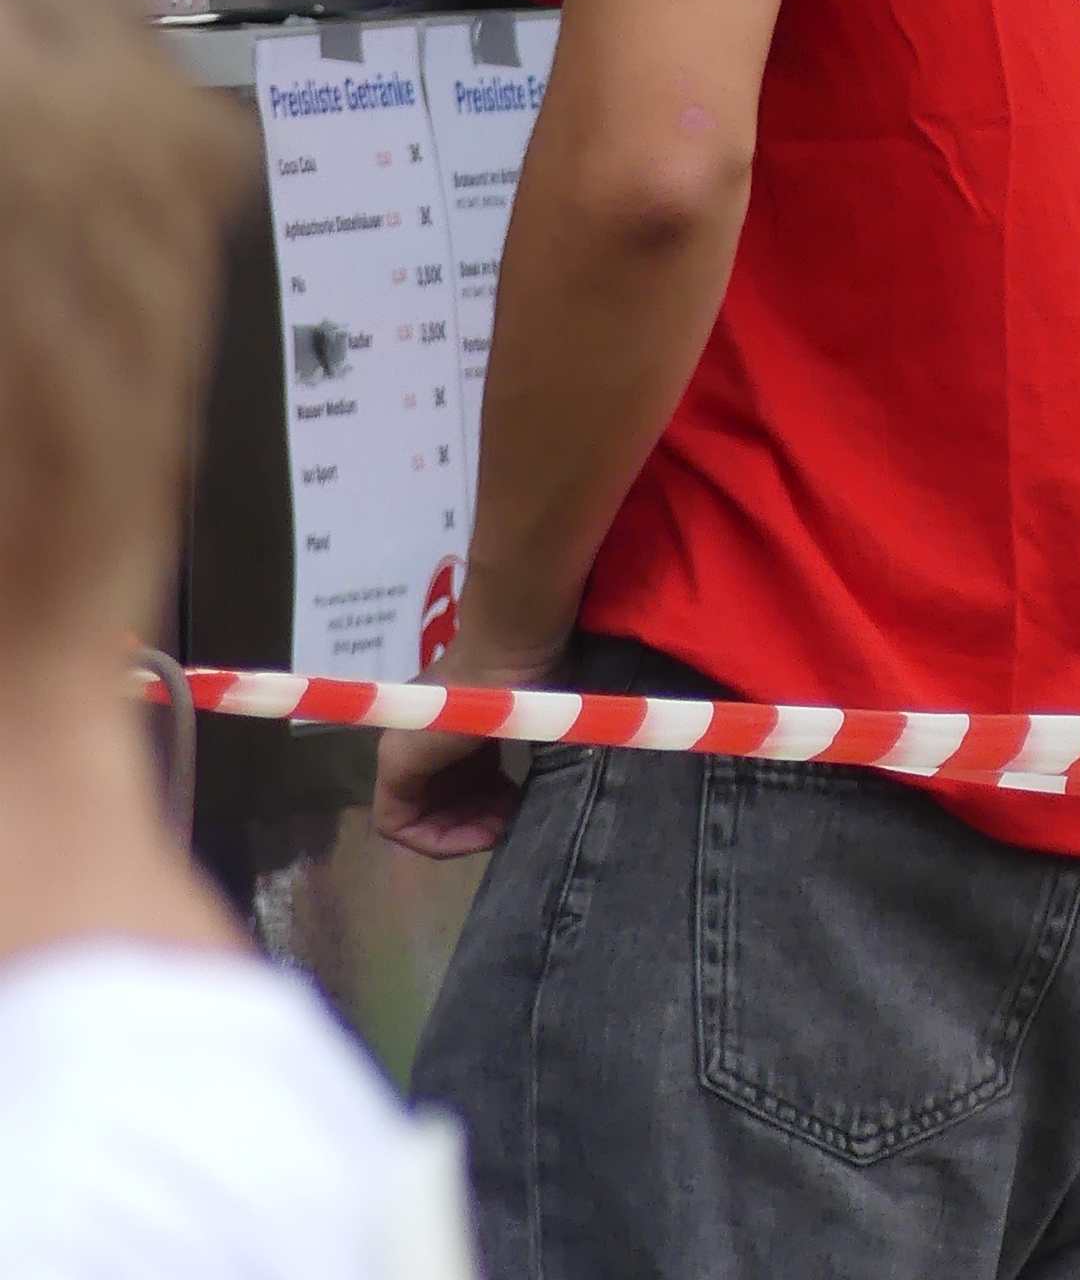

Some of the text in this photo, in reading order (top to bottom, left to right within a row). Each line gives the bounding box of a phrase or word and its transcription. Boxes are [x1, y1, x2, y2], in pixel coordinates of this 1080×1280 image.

[269, 71, 417, 119] Preisliste Getränke
[454, 77, 526, 115] Preisliste
